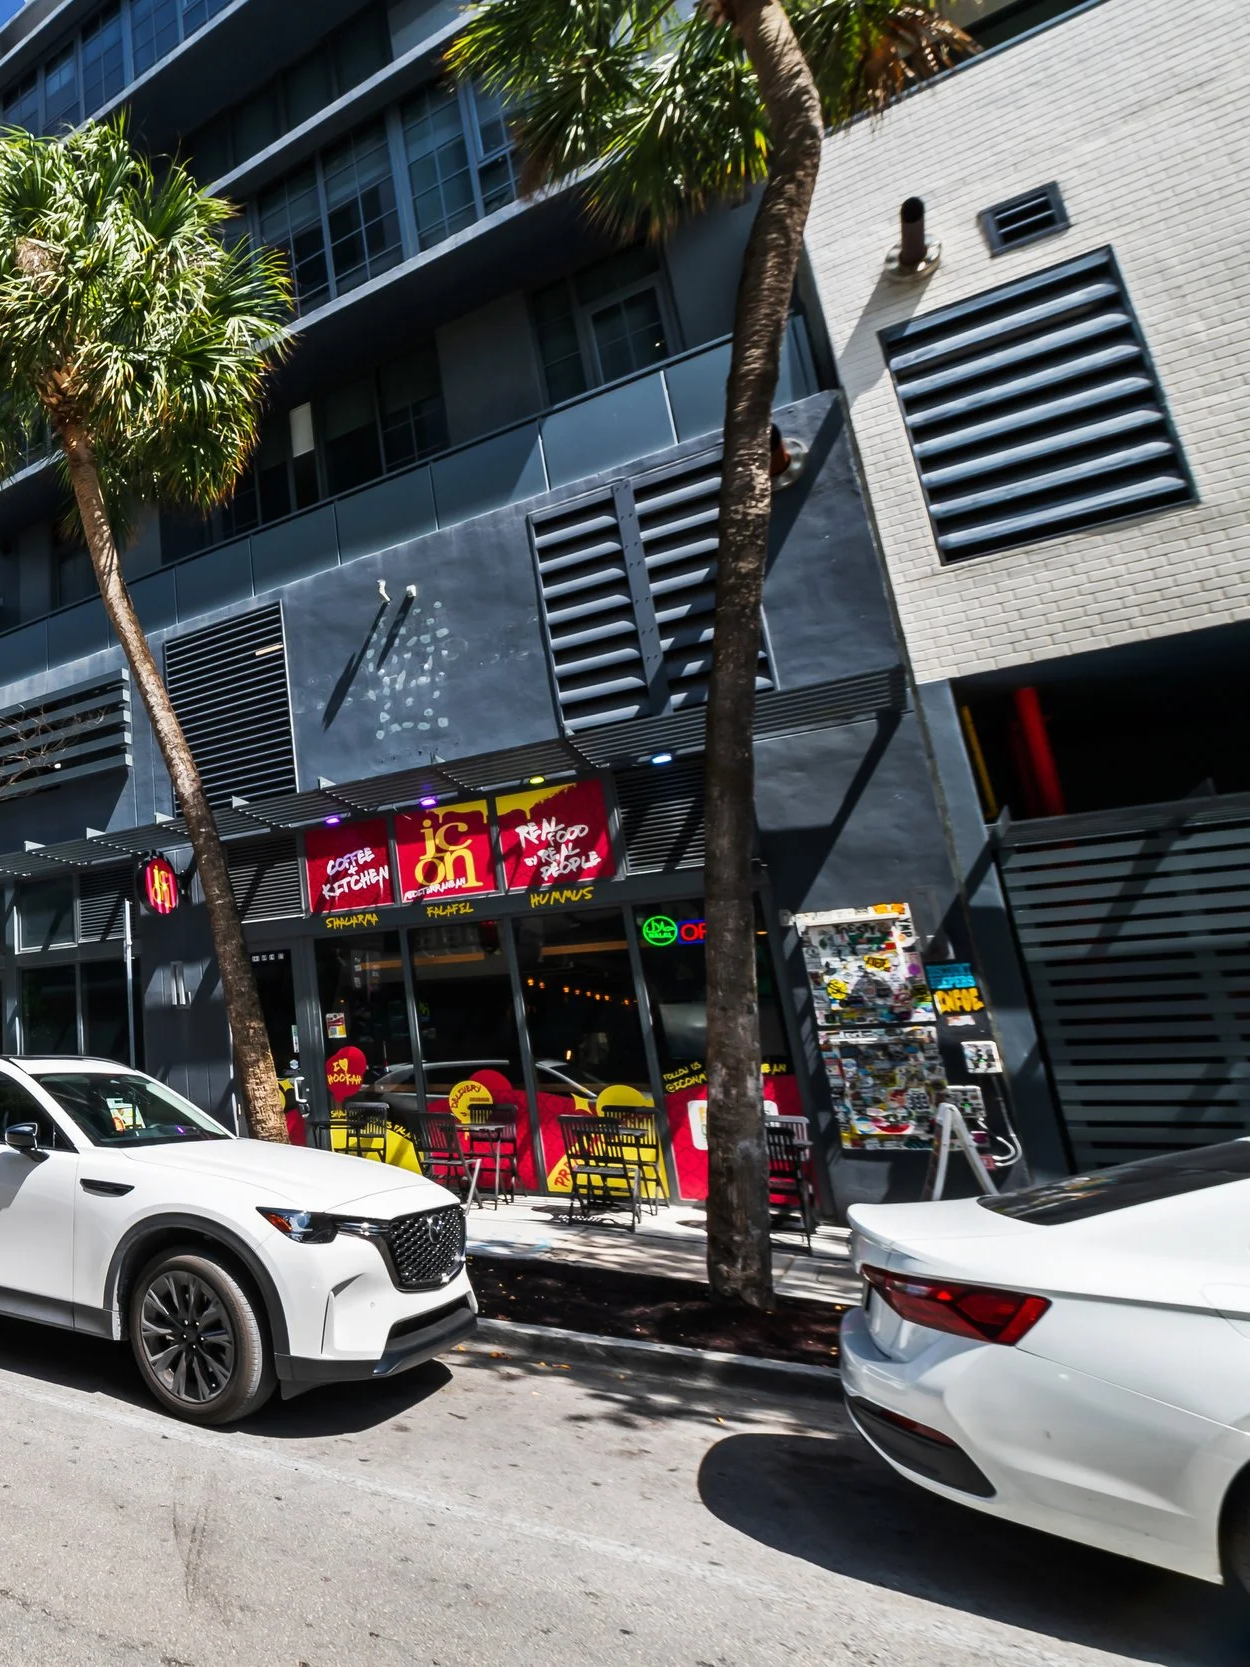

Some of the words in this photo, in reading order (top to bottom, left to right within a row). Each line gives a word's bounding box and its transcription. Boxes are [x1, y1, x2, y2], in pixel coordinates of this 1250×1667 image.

[515, 816, 565, 849] REAL
[547, 824, 589, 846] FOOD
[326, 847, 375, 876] COFFEE
[537, 842, 580, 865] REAL
[540, 851, 601, 881] PEOPLE
[321, 865, 390, 900] KITCHEN
[530, 886, 594, 909] HUMMUS
[325, 912, 379, 931] SHAWARMA
[426, 902, 474, 918] FALAFEL
[327, 1073, 362, 1086] HOOKAH
[662, 1066, 689, 1082] FOLLOW
[451, 1084, 482, 1109] DELIVERY
